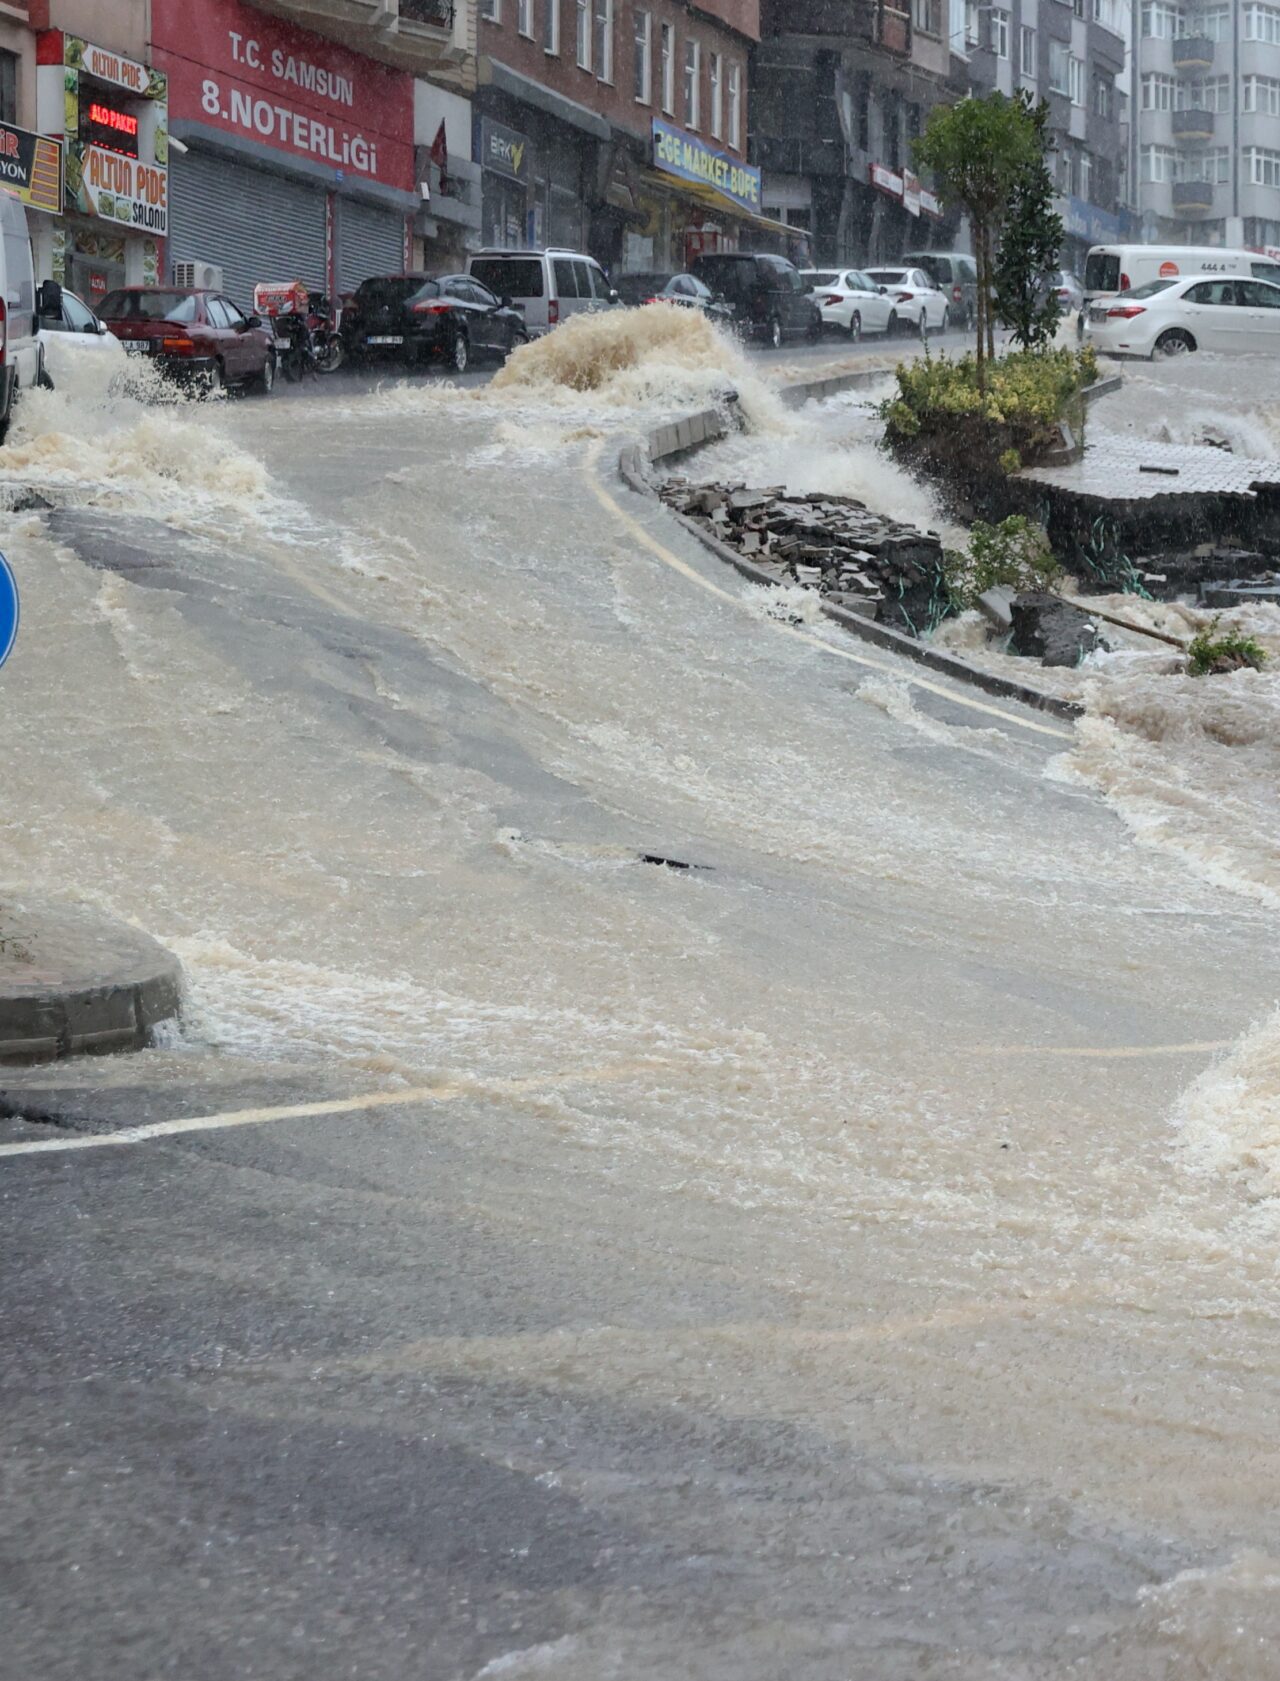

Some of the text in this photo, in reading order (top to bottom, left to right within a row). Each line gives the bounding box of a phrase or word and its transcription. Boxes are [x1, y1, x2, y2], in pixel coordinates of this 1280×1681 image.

[92, 49, 119, 82] ALTUN
[229, 31, 353, 106] T.C. SAMSUN
[90, 103, 138, 135] ALO PAKET
[90, 149, 132, 198] ALTUN
[683, 142, 729, 188] MARKET
[132, 202, 166, 231] SALONU
